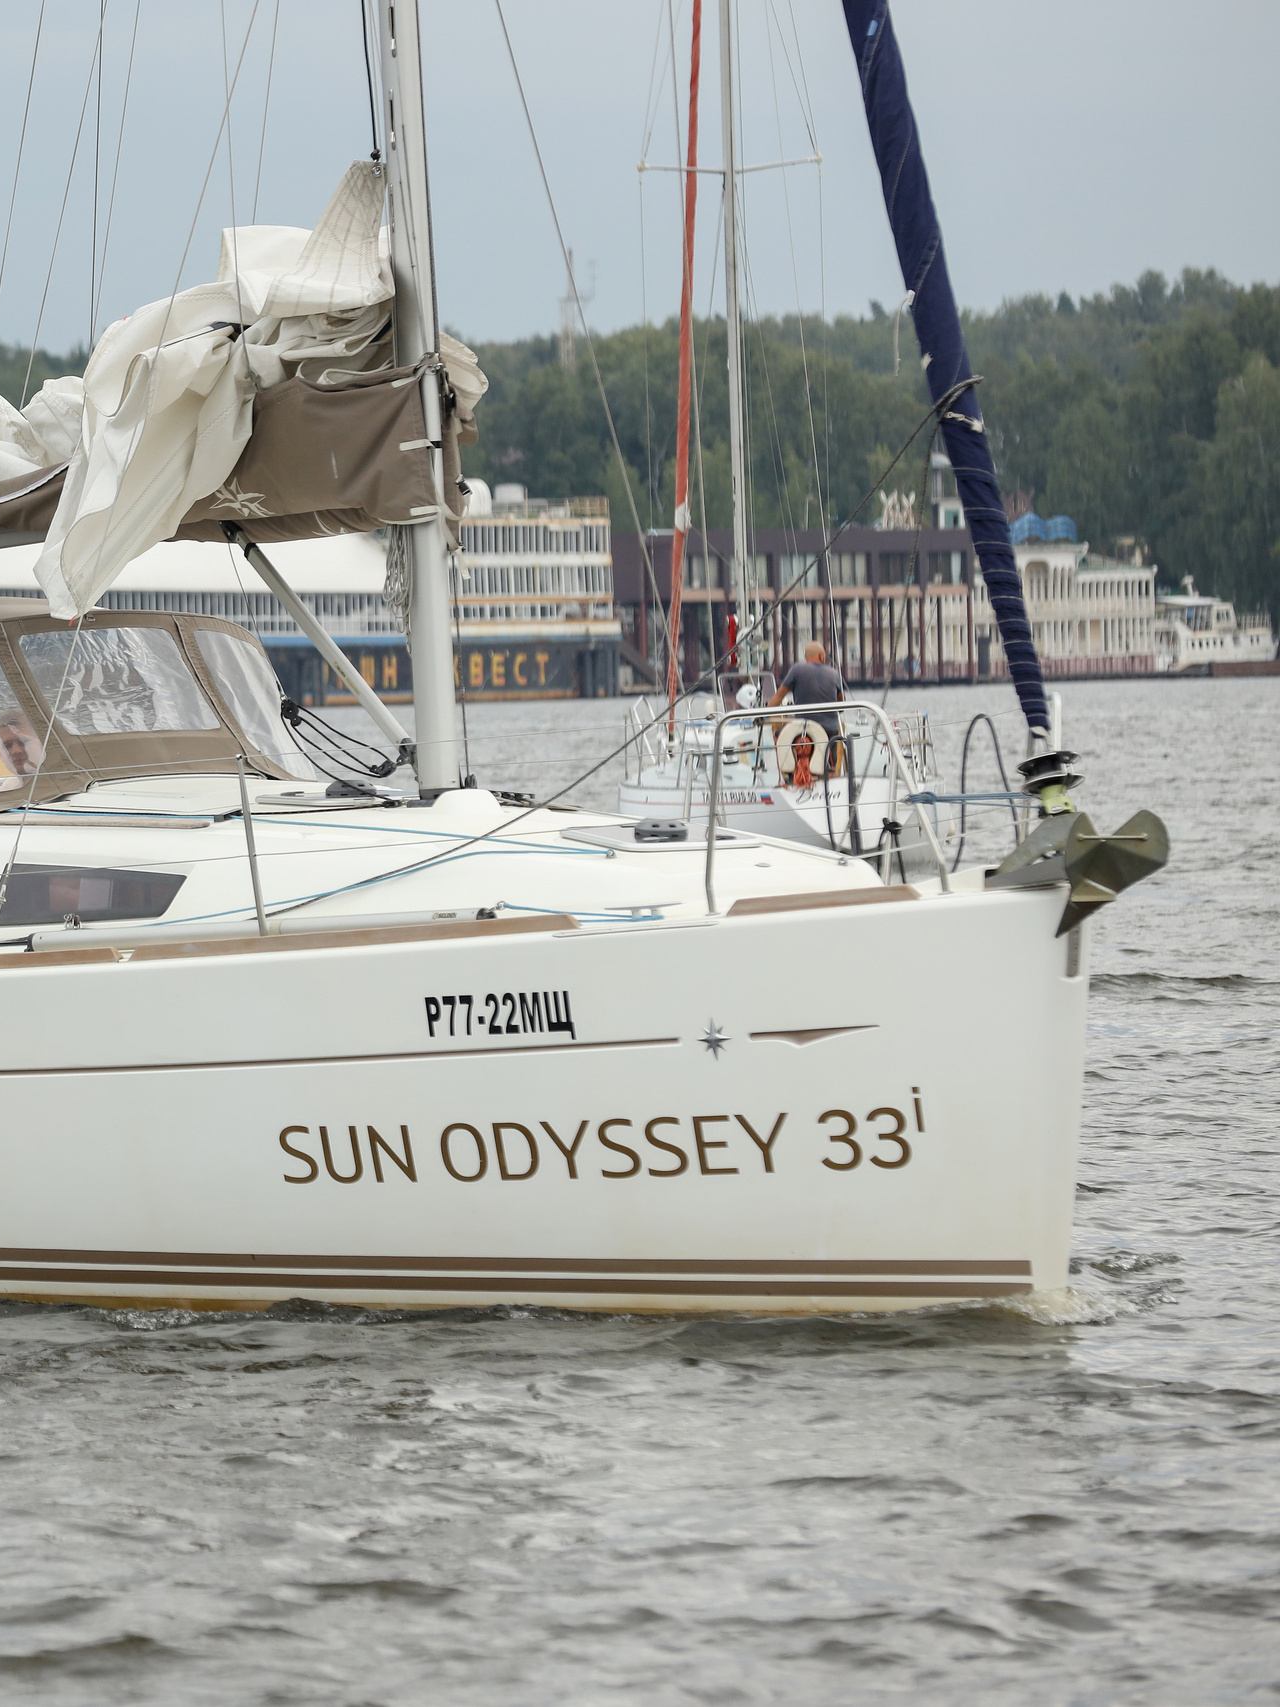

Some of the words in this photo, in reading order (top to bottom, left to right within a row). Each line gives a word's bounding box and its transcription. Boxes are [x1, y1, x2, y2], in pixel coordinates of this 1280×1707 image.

[425, 990, 577, 1041] Р77-22МЩ
[278, 1124, 418, 1185] SUN
[439, 1112, 790, 1183] ODYSSEY
[816, 1086, 926, 1172] 33i
